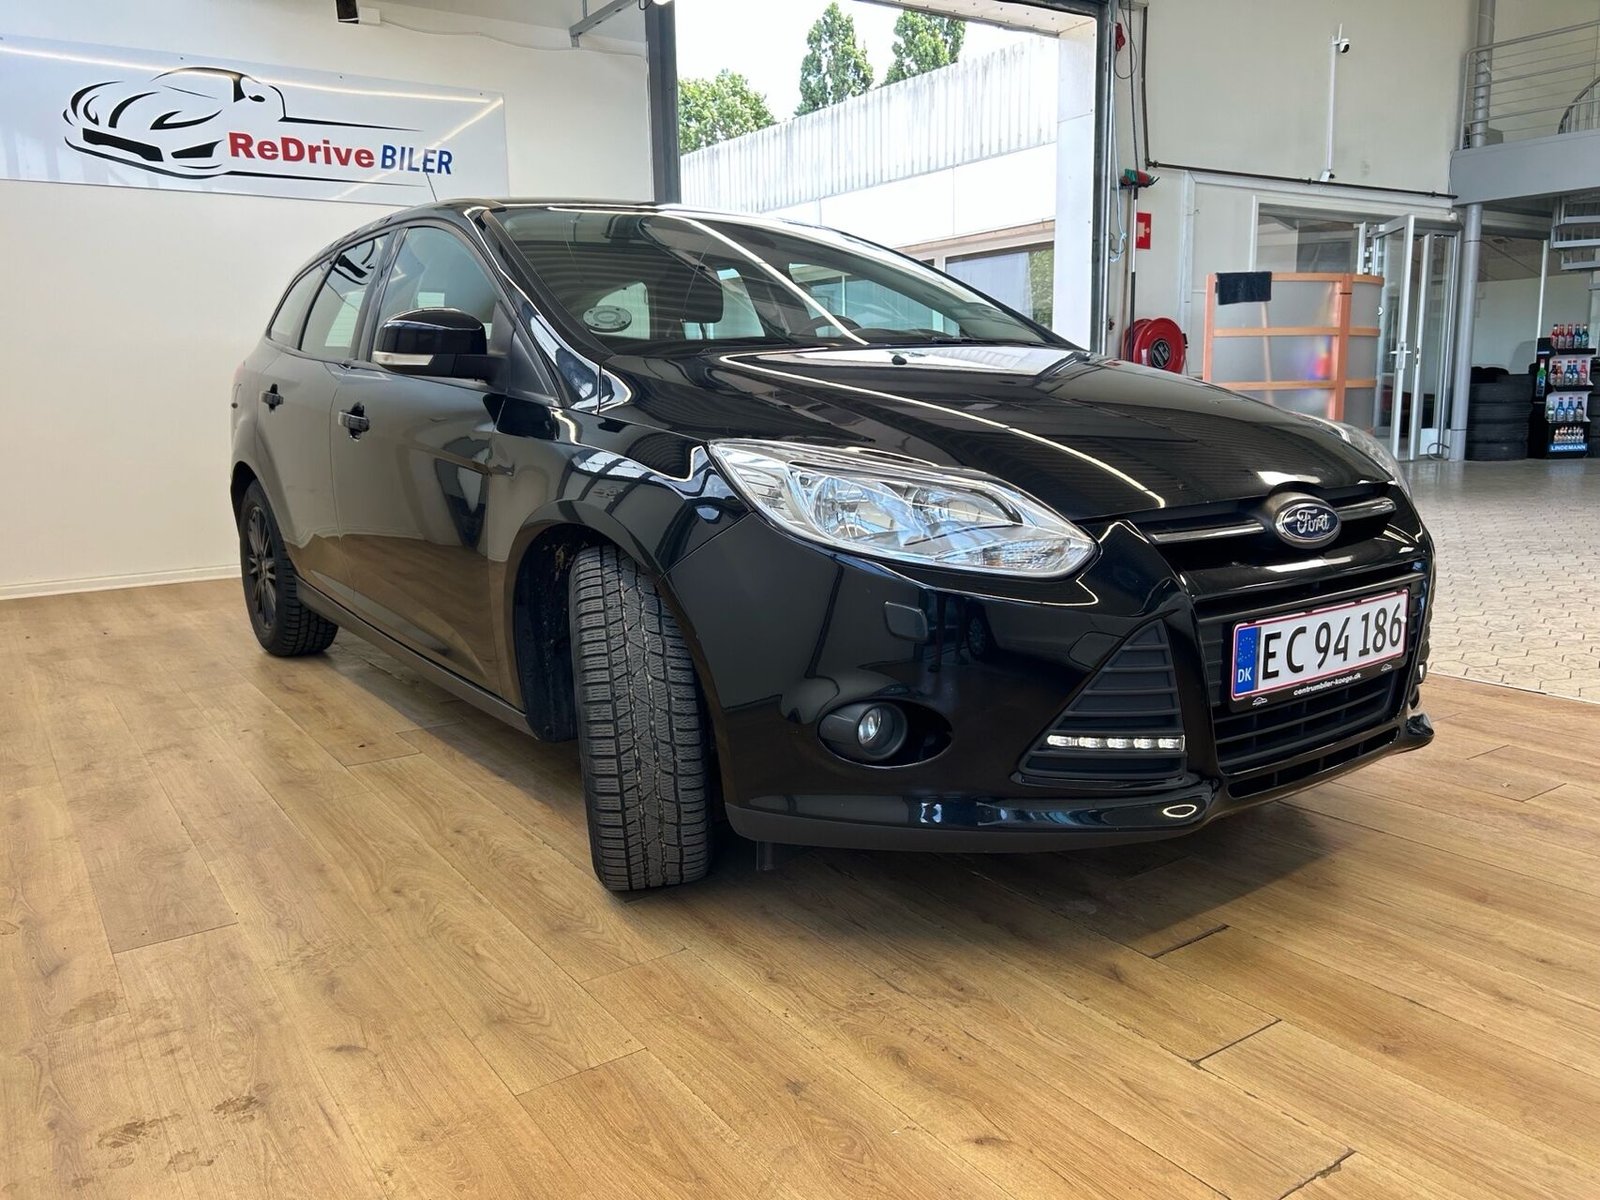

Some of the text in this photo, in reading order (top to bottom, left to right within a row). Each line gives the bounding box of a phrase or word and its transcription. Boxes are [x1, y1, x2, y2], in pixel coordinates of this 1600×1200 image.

[229, 132, 453, 174] ReDrive BILER
[1297, 508, 1330, 534] Ford
[1262, 603, 1402, 680] EC 94 186
[1238, 667, 1252, 683] DK
